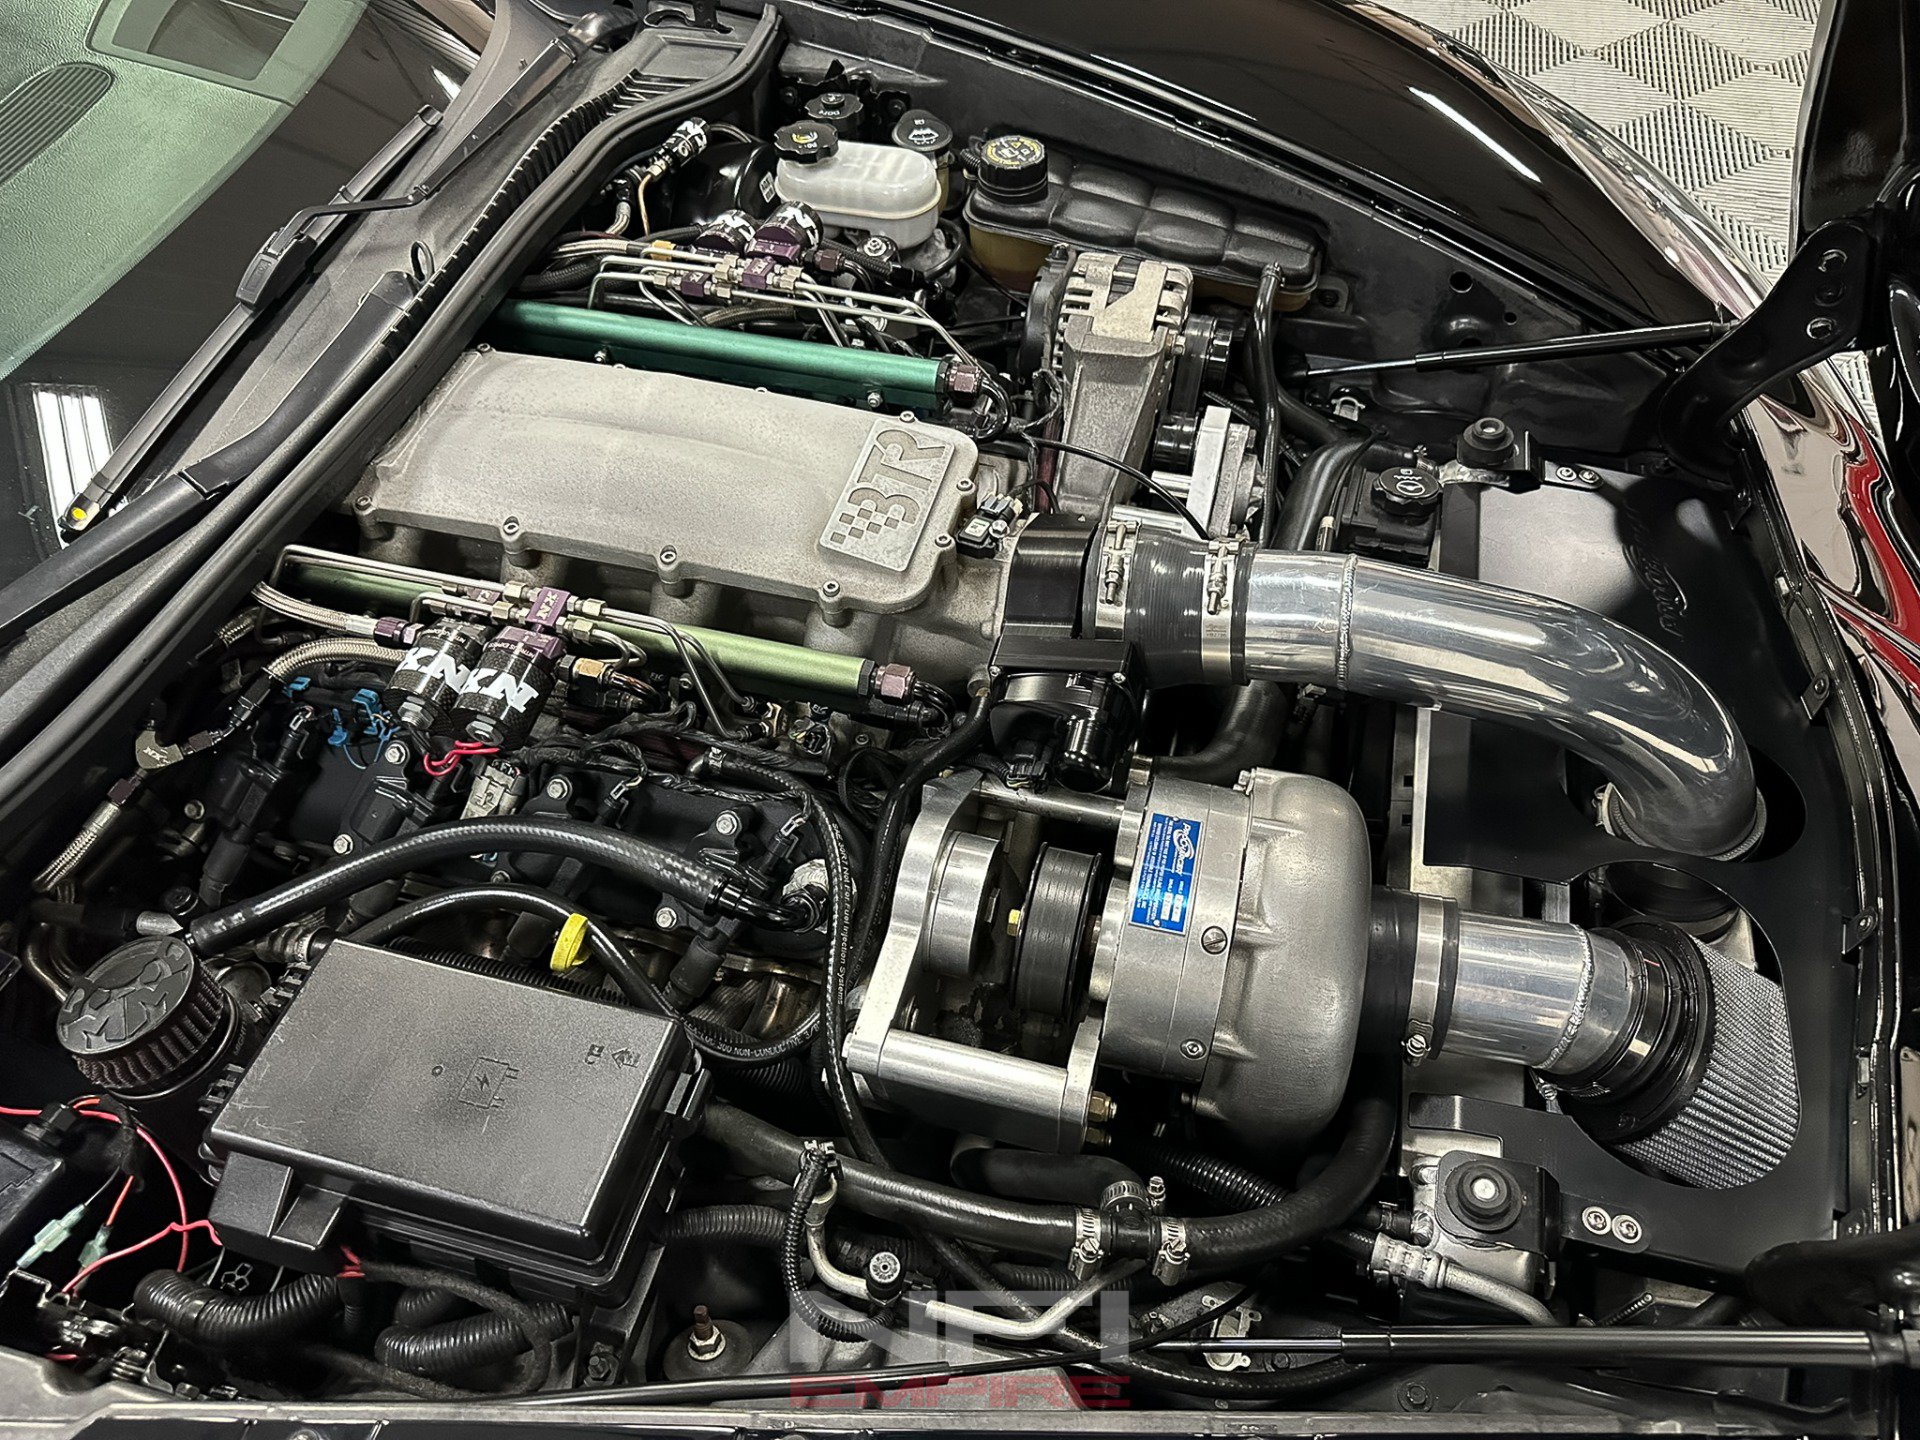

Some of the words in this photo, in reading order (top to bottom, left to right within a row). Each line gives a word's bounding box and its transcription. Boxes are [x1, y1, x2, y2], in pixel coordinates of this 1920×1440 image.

[847, 428, 946, 525] BTR
[832, 822, 843, 841] SAE
[843, 866, 851, 883] Not
[843, 884, 851, 901] For
[843, 902, 851, 924] Fuel
[839, 925, 850, 964] Injection
[836, 965, 847, 1005] Systems
